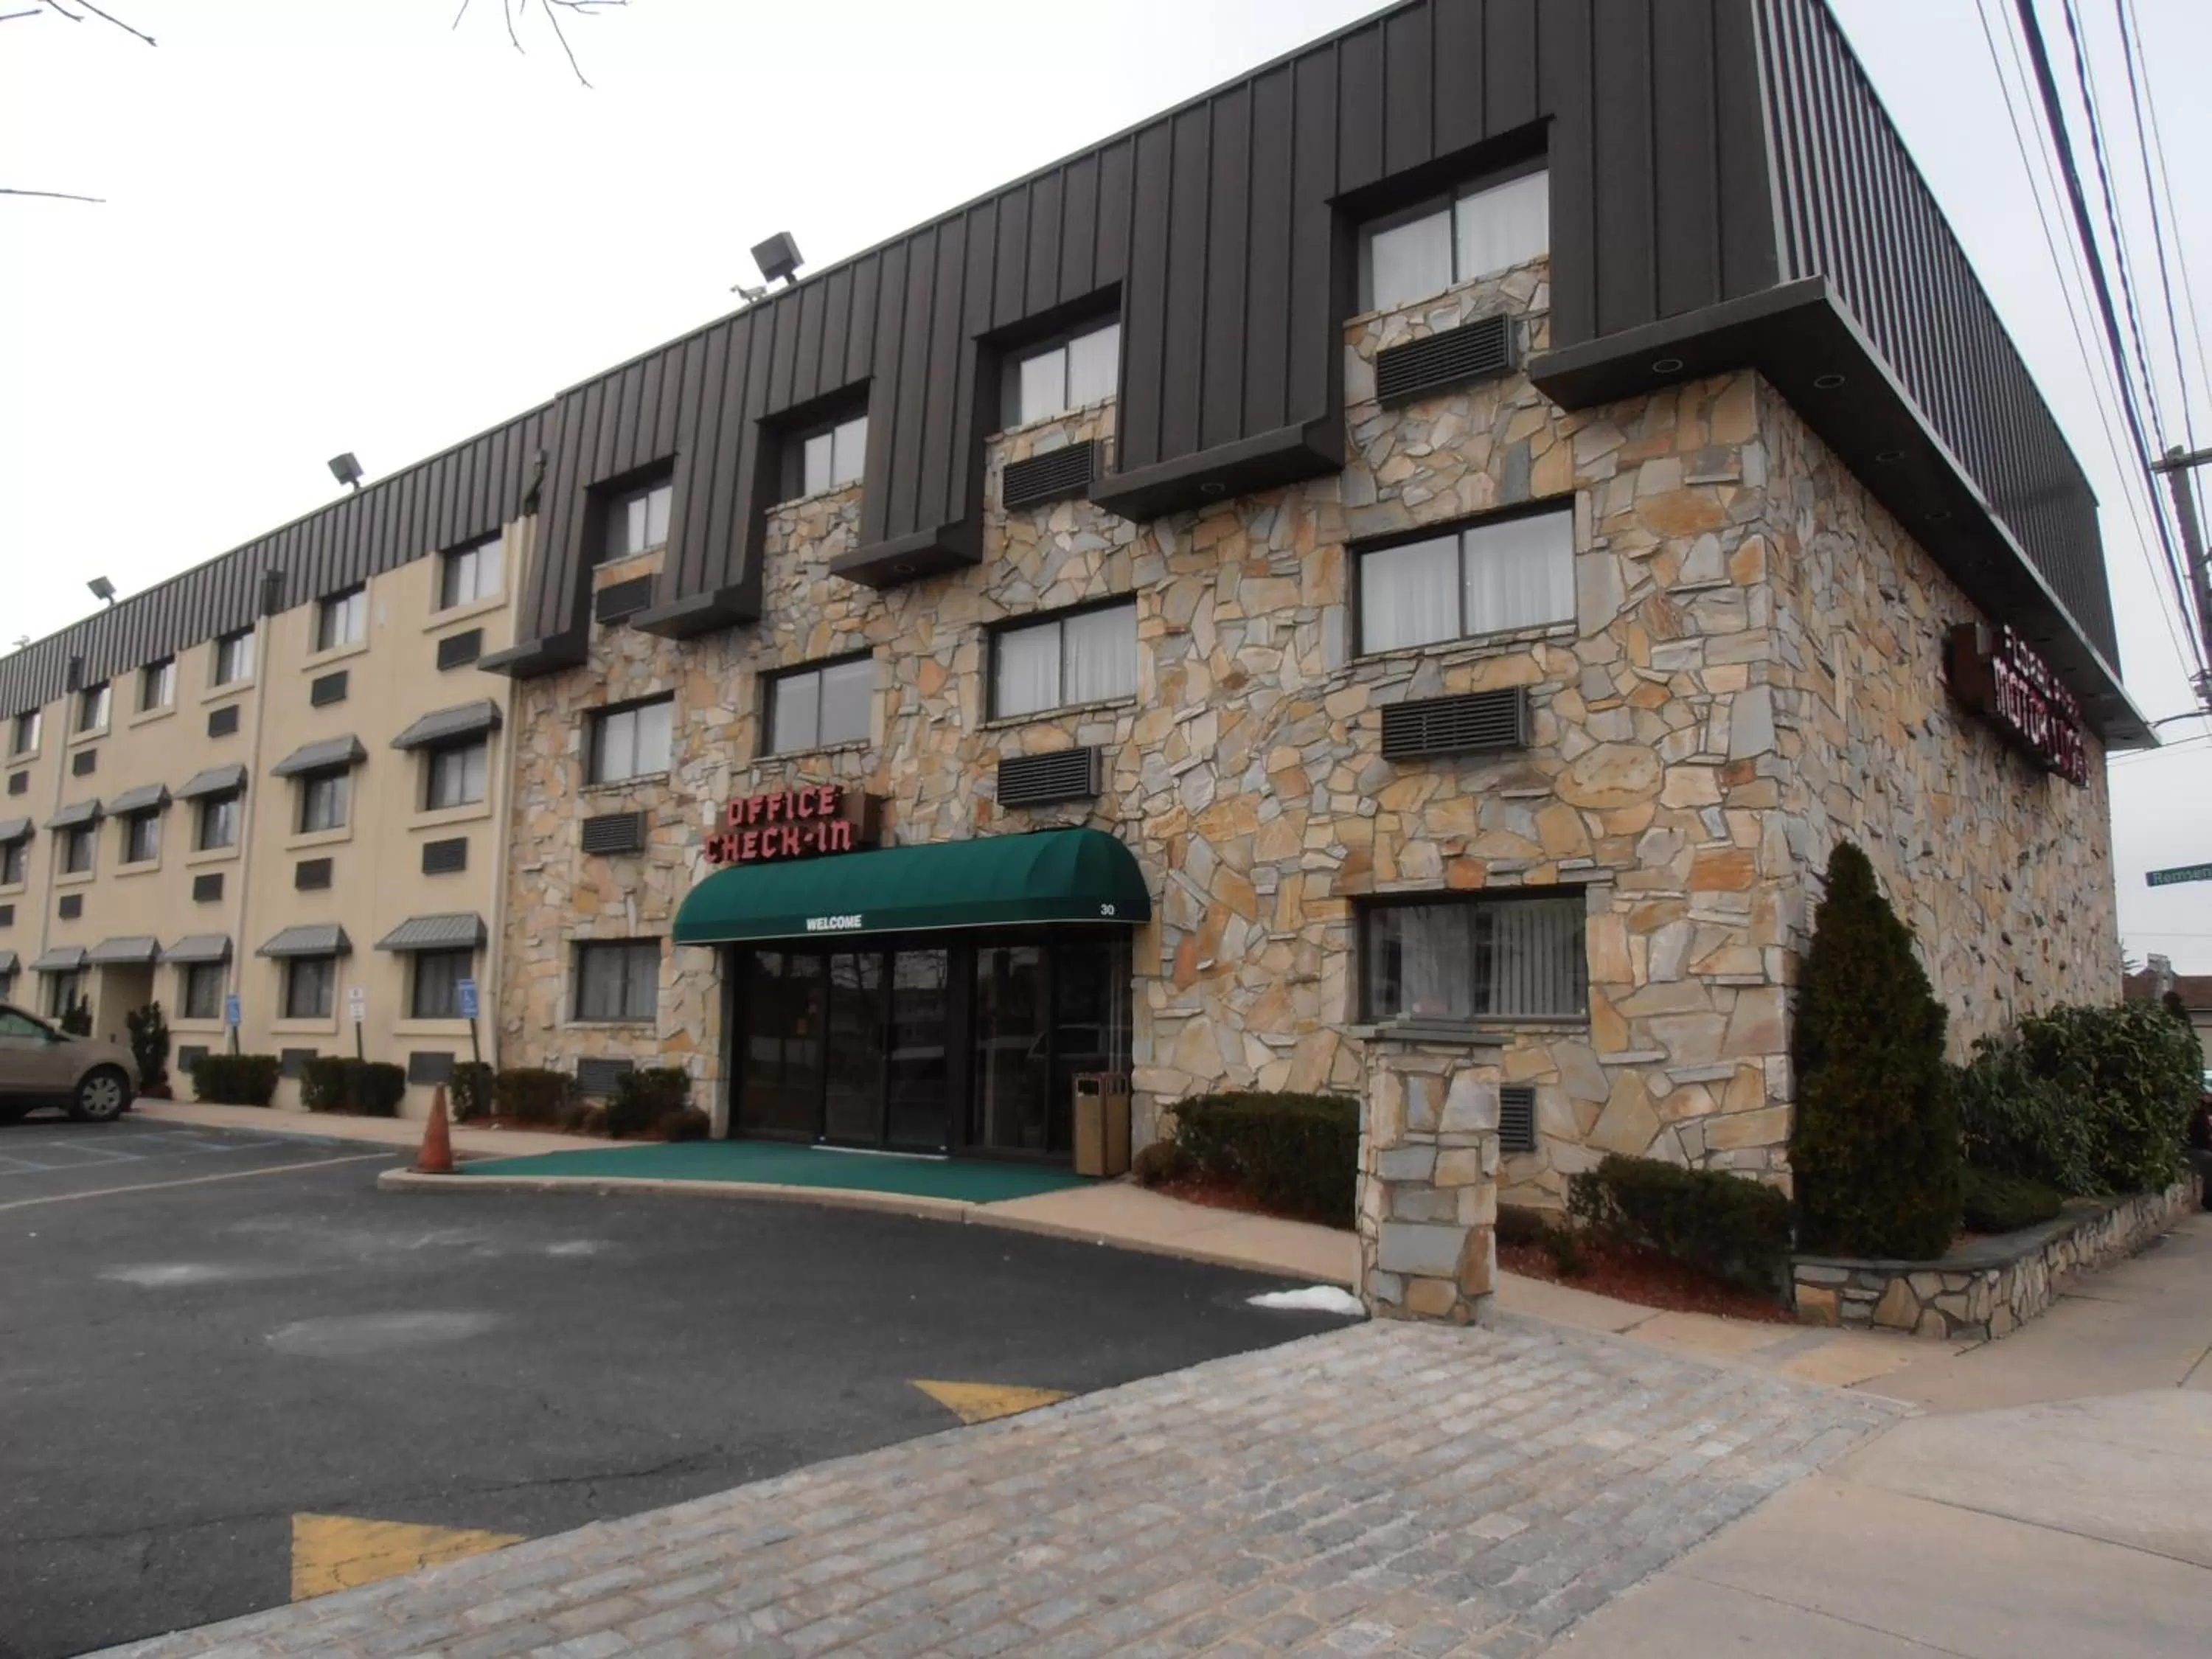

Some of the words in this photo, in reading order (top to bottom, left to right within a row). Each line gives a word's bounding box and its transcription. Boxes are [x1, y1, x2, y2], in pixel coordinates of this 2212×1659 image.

[726, 785, 836, 827] OFFICE
[704, 819, 852, 865] CHECK-IN
[806, 914, 862, 932] WELCOME
[1100, 903, 1114, 915] 30
